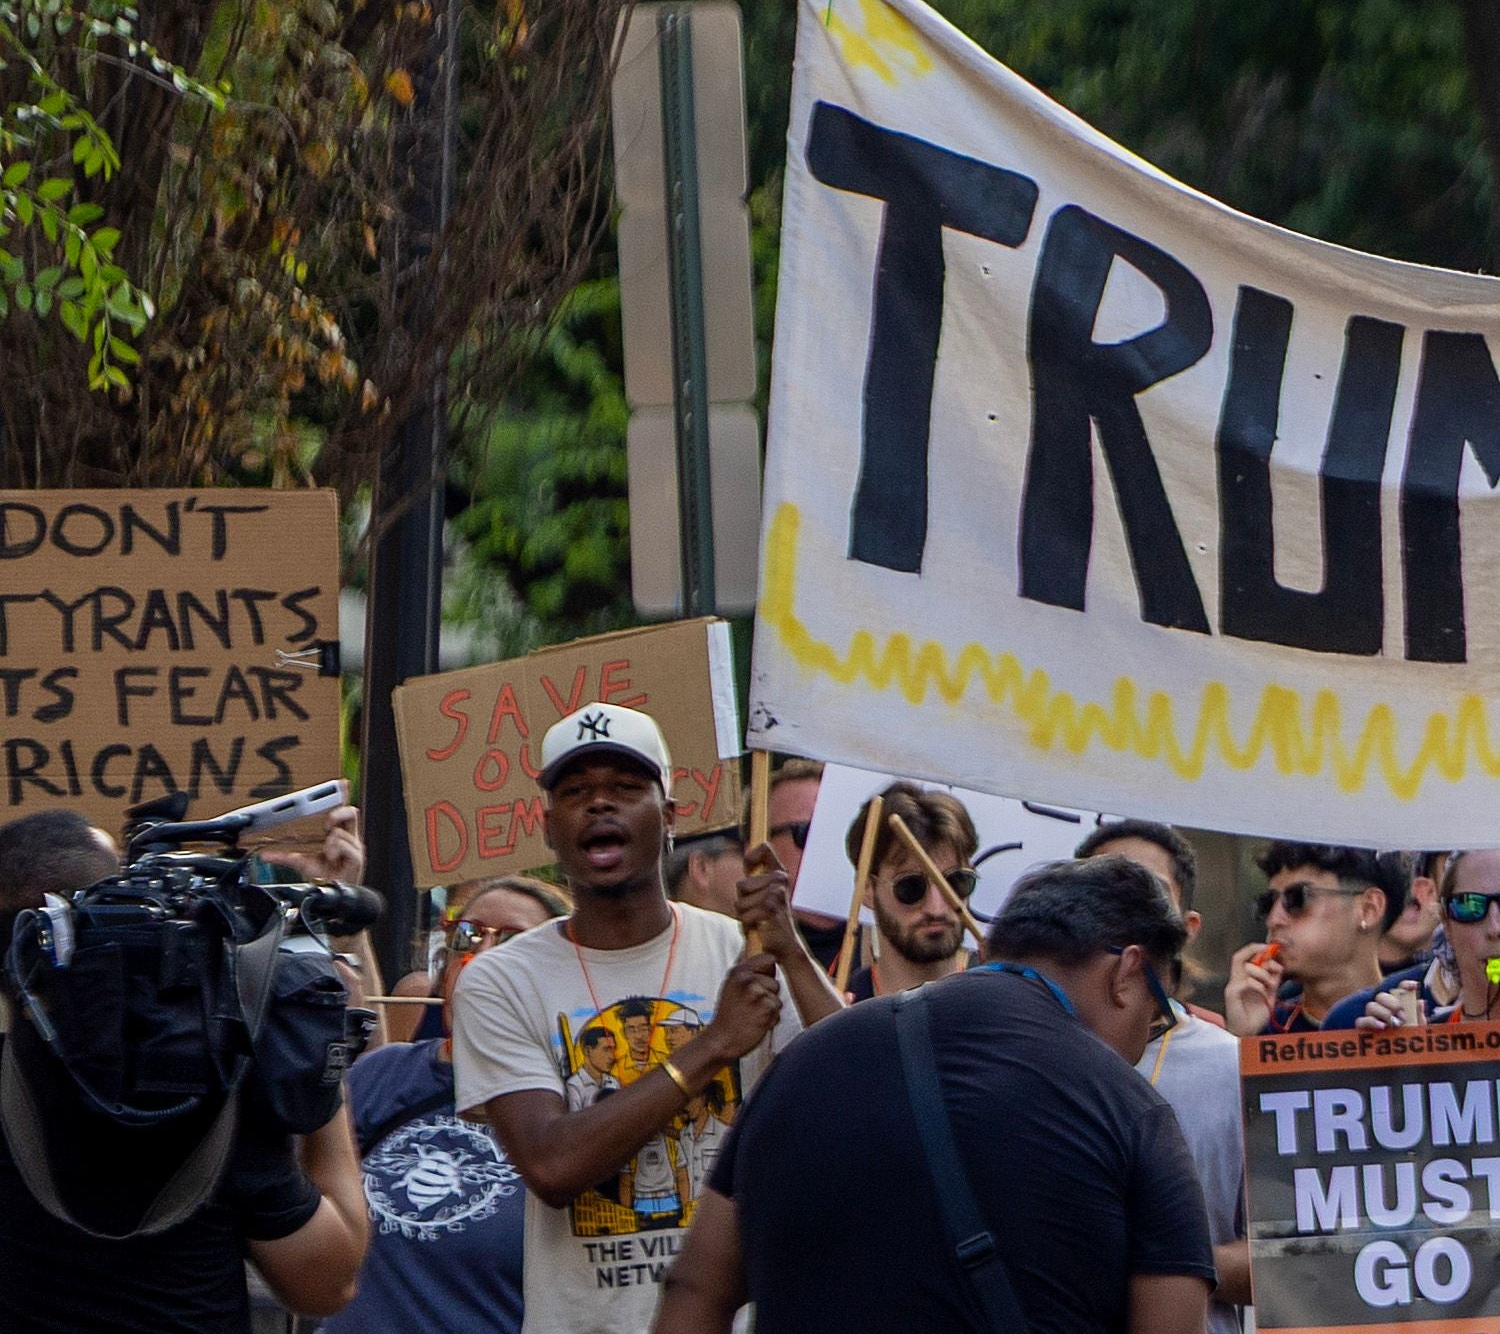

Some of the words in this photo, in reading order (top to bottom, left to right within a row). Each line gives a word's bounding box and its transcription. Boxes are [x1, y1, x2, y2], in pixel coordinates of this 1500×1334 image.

[0, 497, 269, 561] DON'T
[0, 586, 321, 657] TYRANTS
[114, 665, 310, 726] FEAR
[426, 659, 649, 761] SAVE
[583, 1240, 633, 1263] THE
[1353, 1238, 1472, 1308] GO
